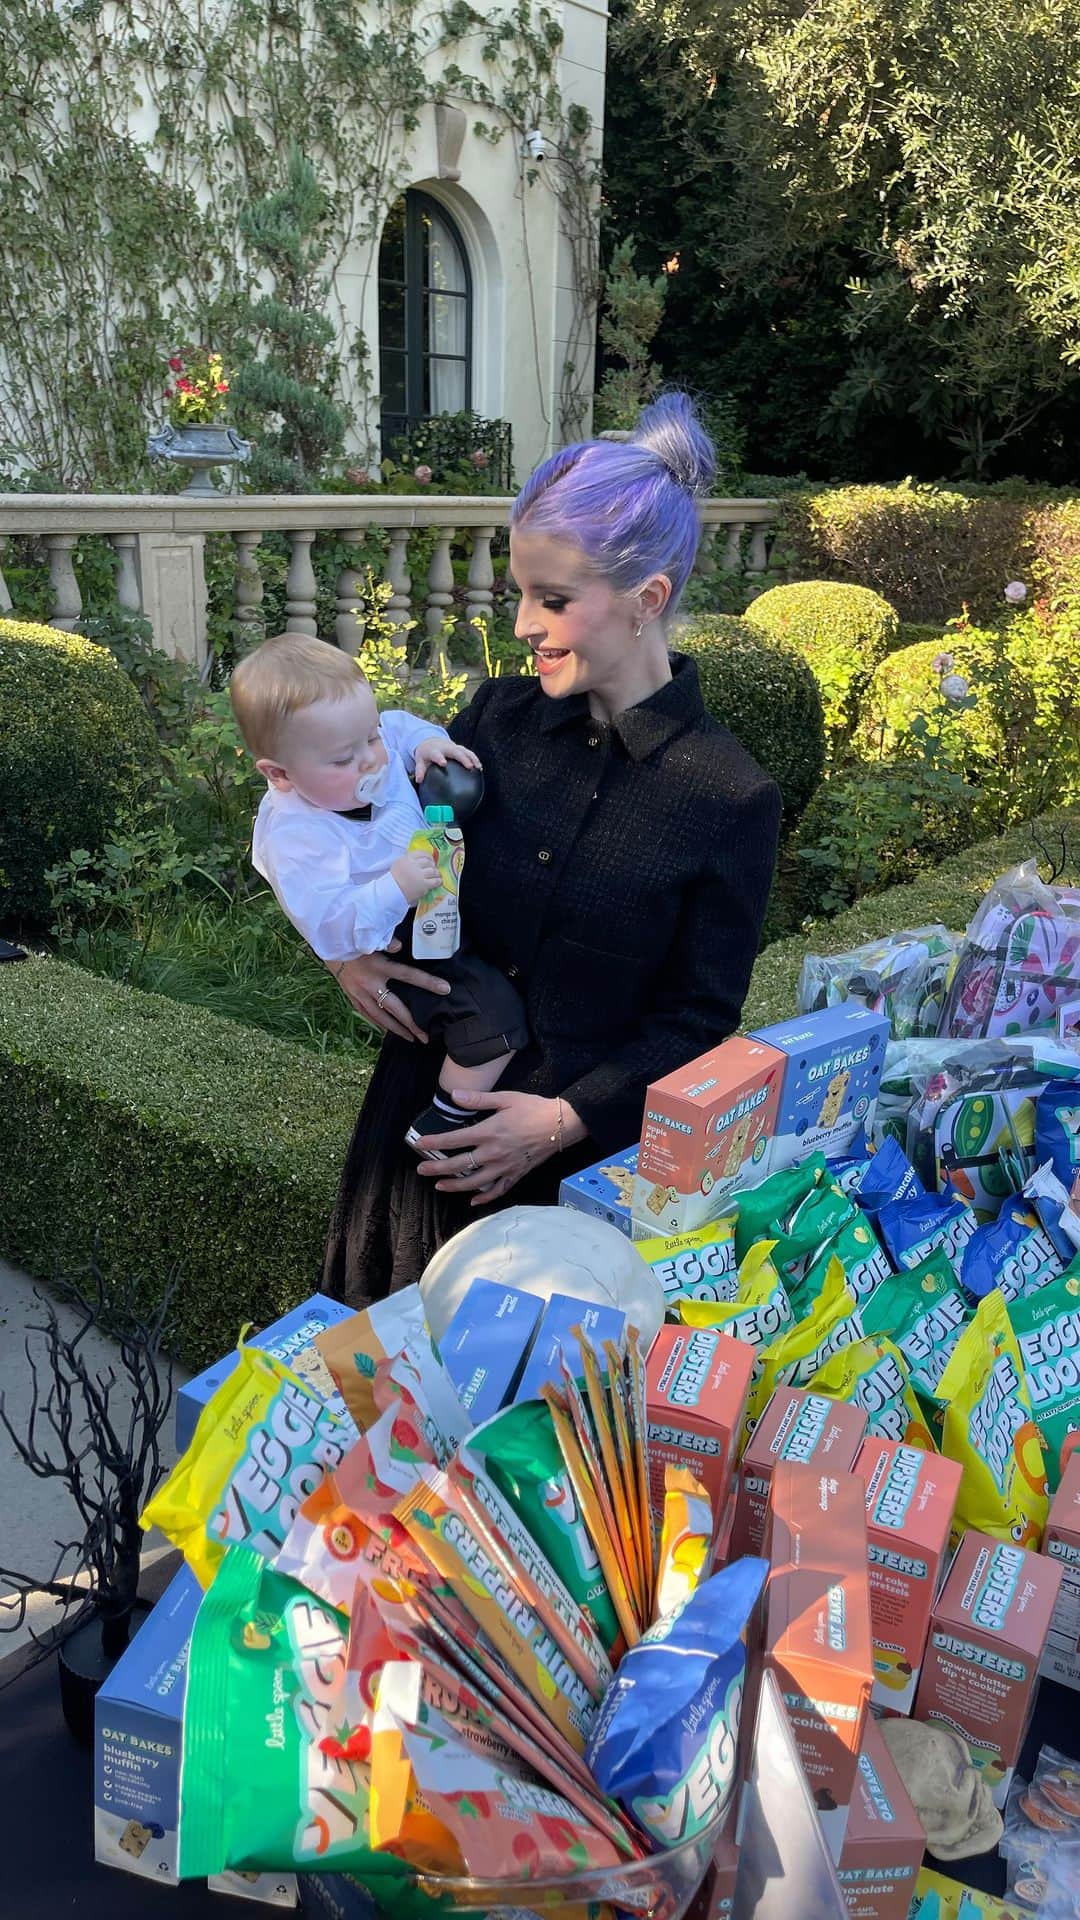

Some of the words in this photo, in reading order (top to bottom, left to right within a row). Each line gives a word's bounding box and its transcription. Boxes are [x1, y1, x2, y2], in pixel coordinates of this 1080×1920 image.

[807, 1063, 831, 1082] OAT
[832, 1047, 870, 1072] BAKES
[647, 1111, 664, 1123] OAT
[664, 1117, 693, 1135] BAKES
[716, 1107, 737, 1132] OAT
[737, 1086, 769, 1118] BAKES
[802, 1131, 832, 1147] blueberry
[268, 1321, 326, 1361] BAKES
[670, 1331, 718, 1405] DIPSTERS
[783, 1396, 832, 1464] DIPSTER
[212, 1381, 325, 1541] VEGGIE
[647, 1448, 678, 1462] onfetti
[875, 1447, 923, 1527] DIPSTERS
[474, 1477, 553, 1600] RIPPERS
[441, 1513, 537, 1642] RIPPERS
[867, 1543, 927, 1579] STERS
[538, 1557, 575, 1610] strawberry
[963, 1590, 974, 1609] TREAT
[976, 1544, 1023, 1628] DIPSTERS
[828, 1585, 845, 1626] BAKES
[828, 1625, 845, 1650] OAT
[934, 1632, 1026, 1680] DIPSTERS
[937, 1655, 977, 1678] brownie
[979, 1672, 1012, 1691] batter
[157, 1670, 176, 1696] OAT
[273, 1667, 291, 1699] spoon
[941, 1667, 958, 1678] dip
[968, 1678, 1007, 1698] cookies
[680, 1702, 707, 1738] little
[701, 1676, 721, 1709] spoon
[802, 1698, 860, 1721] BAKES
[102, 1727, 127, 1743] OAT
[130, 1736, 173, 1757] BAKES
[265, 1708, 285, 1750] little
[461, 1725, 510, 1754] strawberry
[103, 1743, 160, 1769] blueberry
[103, 1754, 141, 1772] muffin
[858, 1754, 882, 1795] BAKES
[873, 1796, 895, 1821] OAT
[864, 1866, 912, 1879] BAKES
